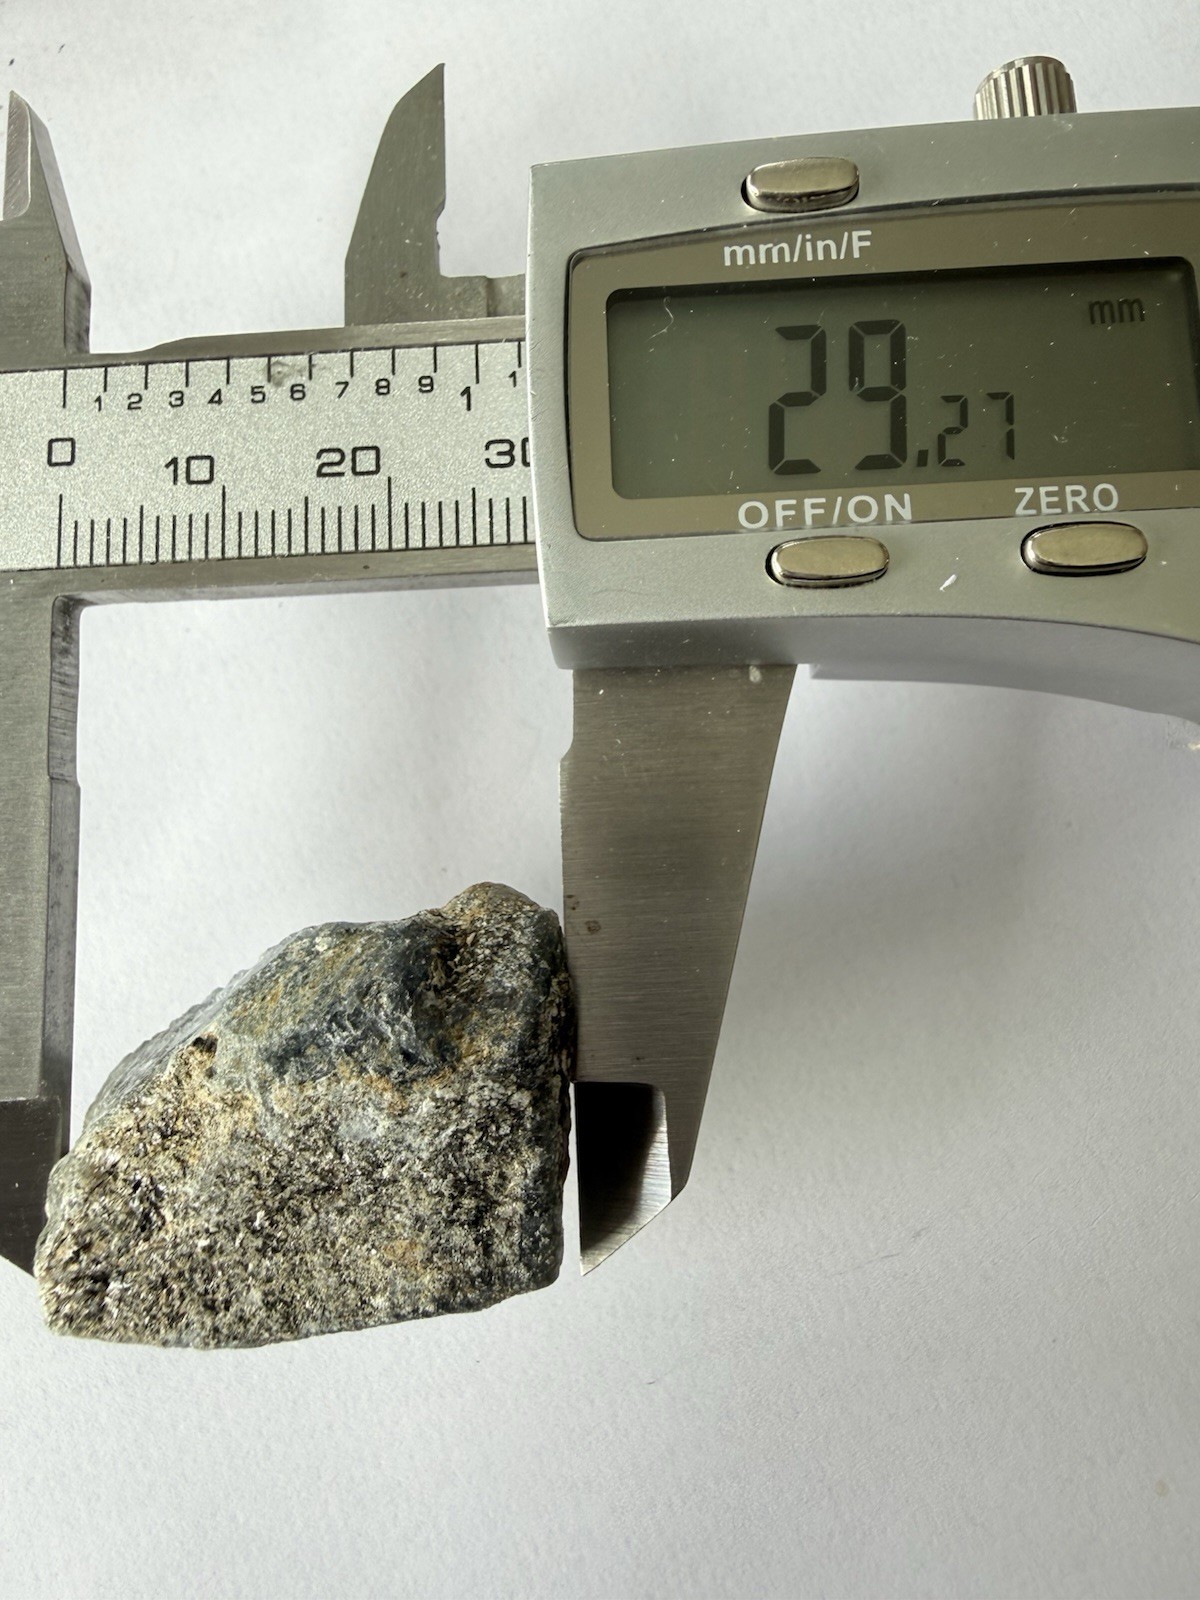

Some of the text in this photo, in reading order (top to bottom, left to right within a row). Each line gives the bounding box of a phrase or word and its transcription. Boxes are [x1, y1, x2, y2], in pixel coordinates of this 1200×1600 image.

[723, 229, 873, 267] mm/in/F
[1088, 297, 1145, 325] mm
[94, 396, 103, 412] 1
[127, 393, 143, 410] 2
[168, 390, 185, 408] 3
[208, 388, 223, 405] 4
[250, 385, 266, 404] 5
[290, 383, 306, 401] 6
[336, 380, 350, 399] 7
[375, 378, 391, 396] 8
[417, 375, 435, 393] 9
[460, 386, 472, 412] 1
[768, 318, 1016, 477] 29.27
[164, 454, 215, 485] 10
[316, 446, 381, 477] 20
[485, 438, 529, 468] 3
[738, 492, 913, 531] OFF/ON
[1014, 482, 1120, 517] ZERO
